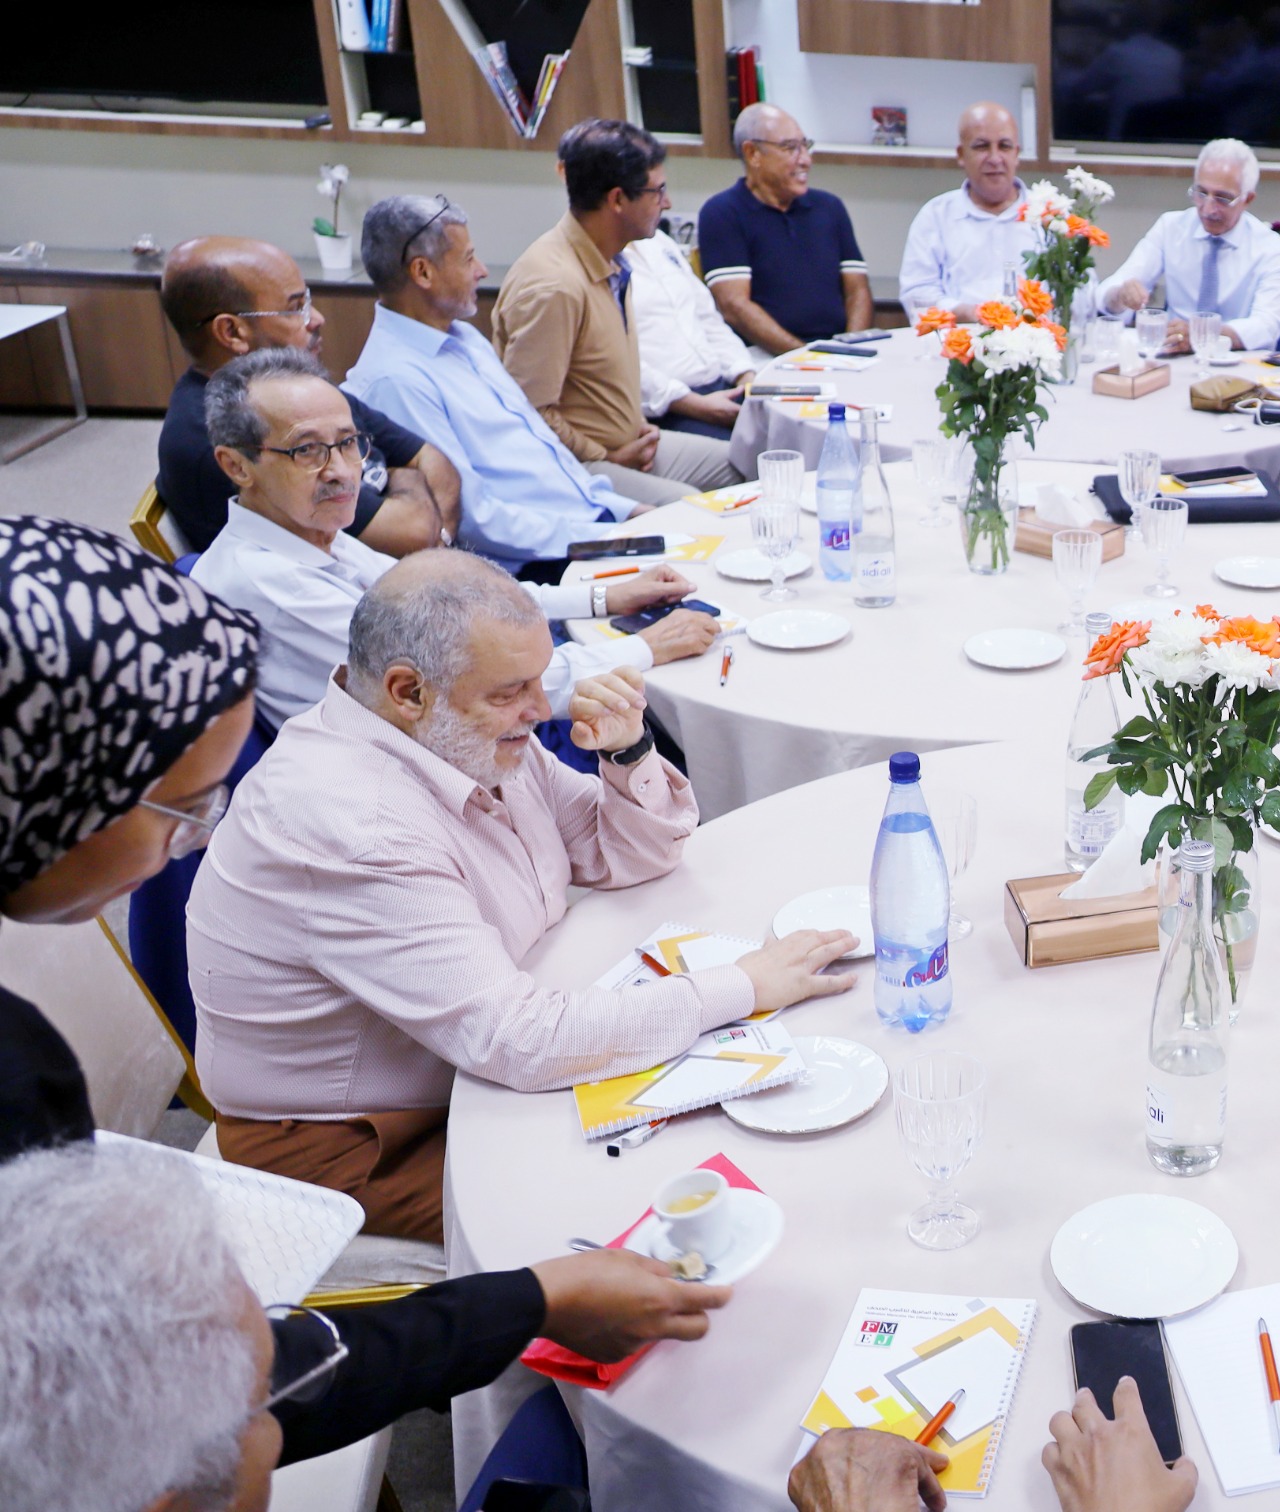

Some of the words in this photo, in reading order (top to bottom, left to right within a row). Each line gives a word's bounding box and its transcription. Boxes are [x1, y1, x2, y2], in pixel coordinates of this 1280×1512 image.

[862, 568, 879, 577] sidi
[880, 567, 891, 576] ali
[1149, 1106, 1164, 1124] ali
